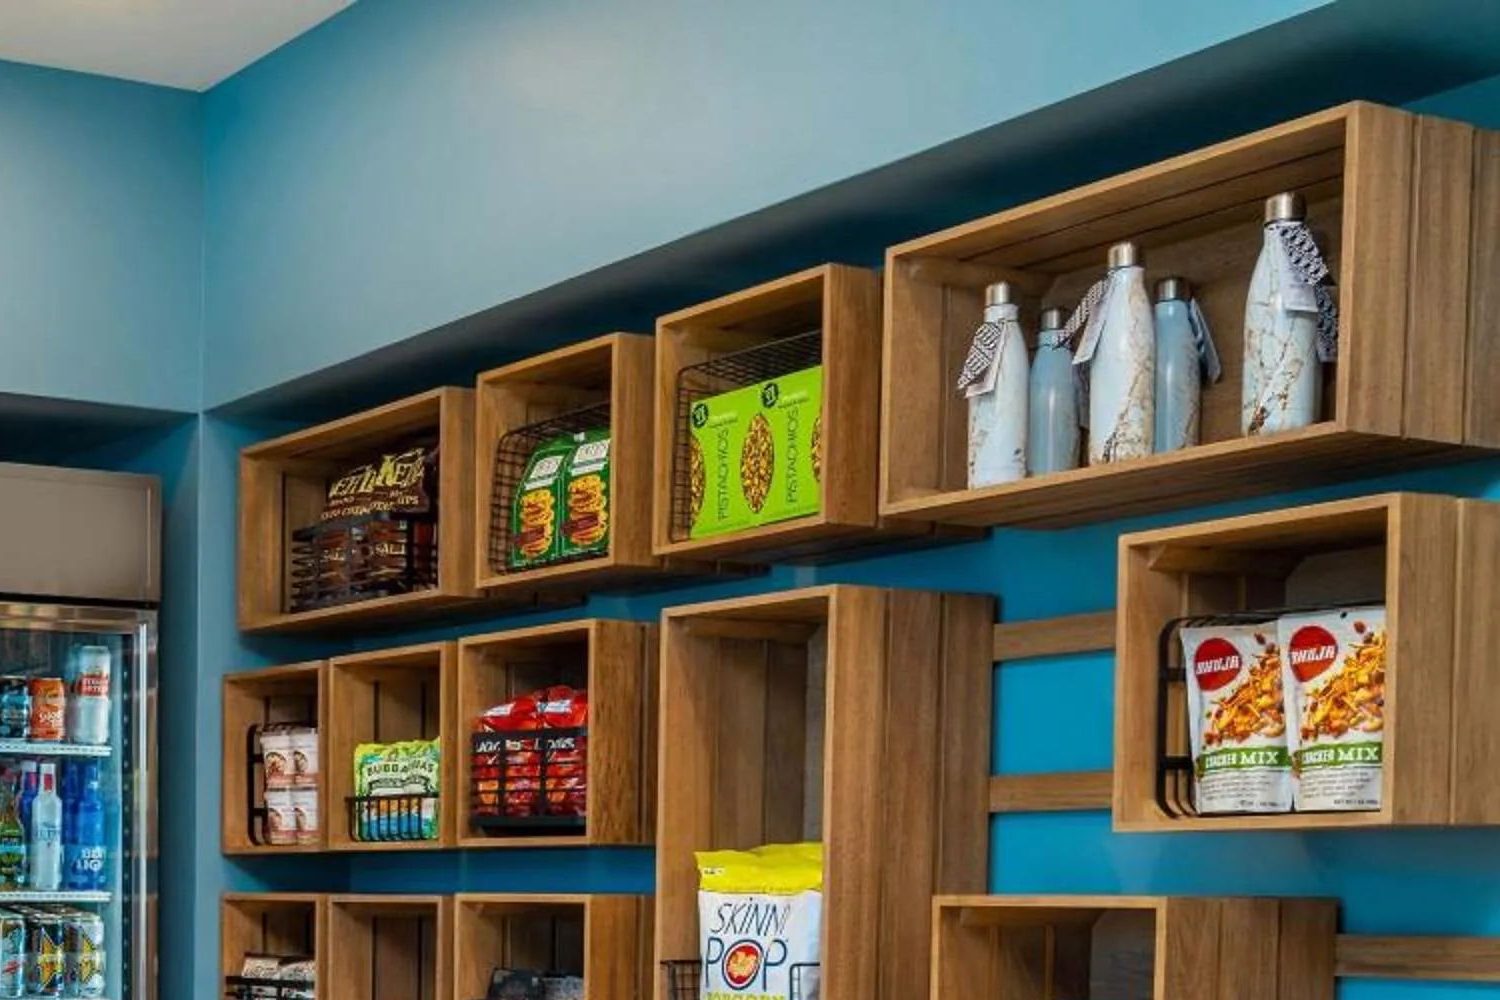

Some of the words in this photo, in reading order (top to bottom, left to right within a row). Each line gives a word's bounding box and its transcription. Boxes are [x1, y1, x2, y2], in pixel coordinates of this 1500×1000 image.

[1240, 751, 1279, 765] MIX
[1337, 747, 1379, 761] MIX
[705, 936, 789, 993] POP
